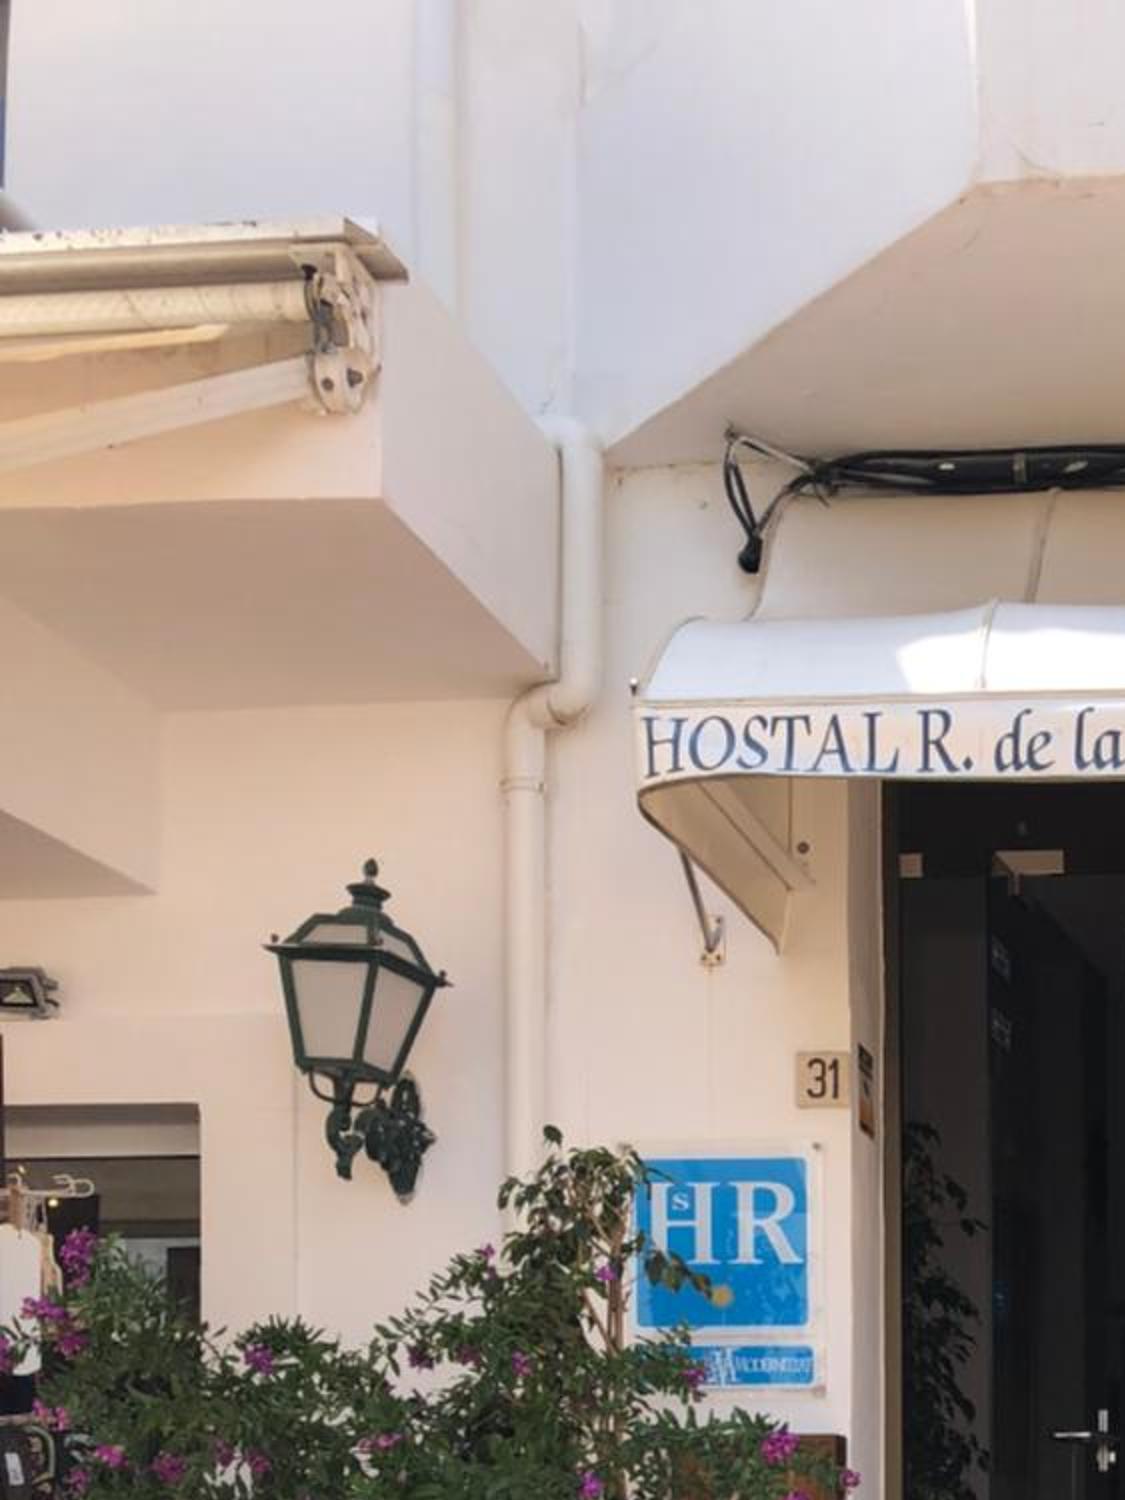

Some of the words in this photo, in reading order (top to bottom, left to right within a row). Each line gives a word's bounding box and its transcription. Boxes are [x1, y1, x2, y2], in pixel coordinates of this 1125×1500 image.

[641, 711, 901, 778] HOSTAL
[916, 708, 974, 774] R.
[993, 707, 1056, 772] de
[806, 1056, 840, 1100] 31
[646, 1180, 804, 1265] HR
